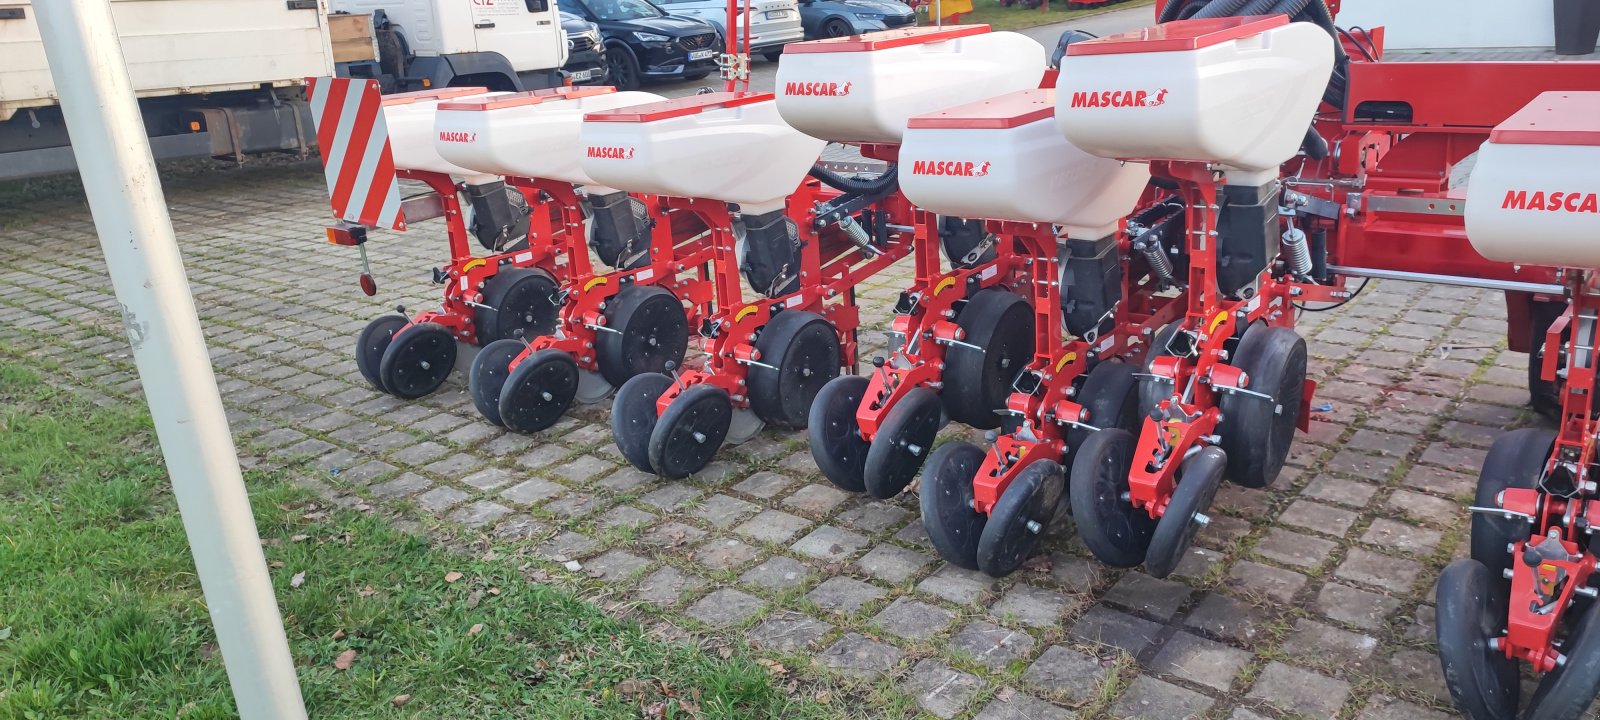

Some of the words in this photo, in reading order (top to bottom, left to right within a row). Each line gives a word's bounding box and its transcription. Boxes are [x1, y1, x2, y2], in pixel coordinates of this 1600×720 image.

[785, 82, 838, 97] MASCAR
[1071, 90, 1147, 108] MASCAR
[439, 131, 469, 143] MASCAR
[587, 146, 625, 159] MASCAR
[912, 160, 974, 177] MASCAR
[1501, 190, 1600, 213] MASCA
